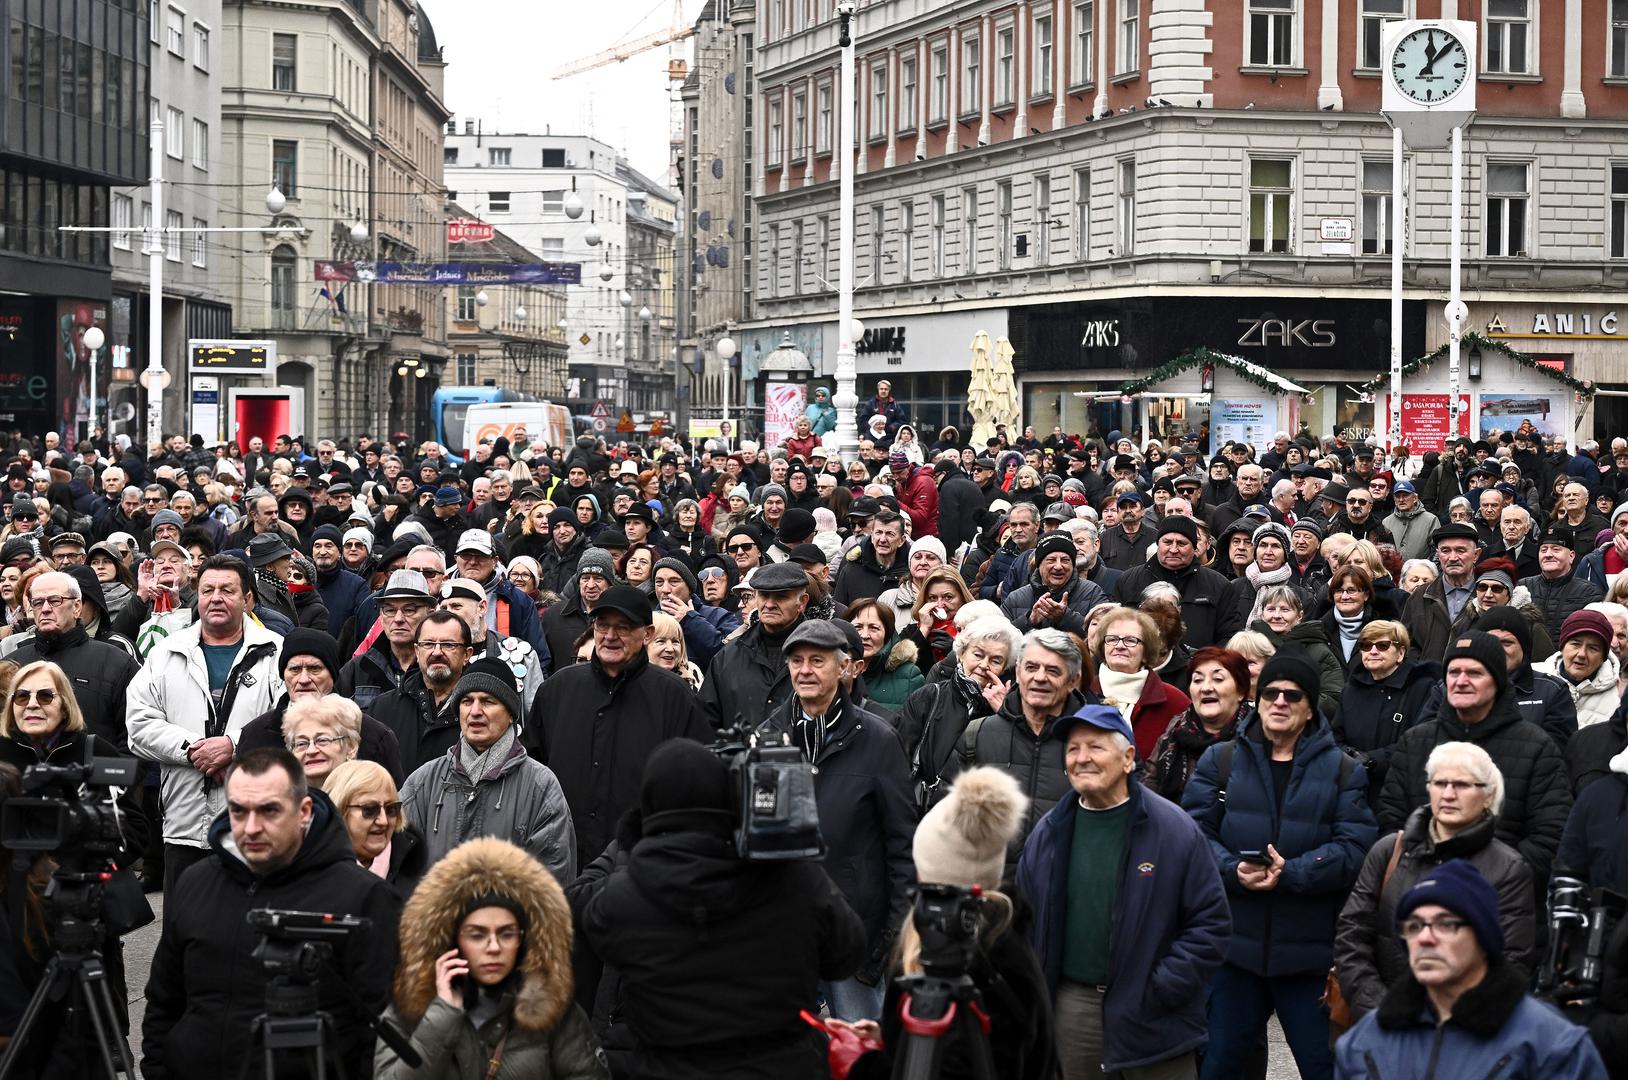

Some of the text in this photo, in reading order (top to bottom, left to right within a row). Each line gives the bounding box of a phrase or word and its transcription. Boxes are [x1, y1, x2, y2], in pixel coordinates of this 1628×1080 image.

[1081, 319, 1119, 347] ZAKS
[1237, 318, 1336, 347] ZAKS
[1532, 311, 1618, 335] ANIĆ
